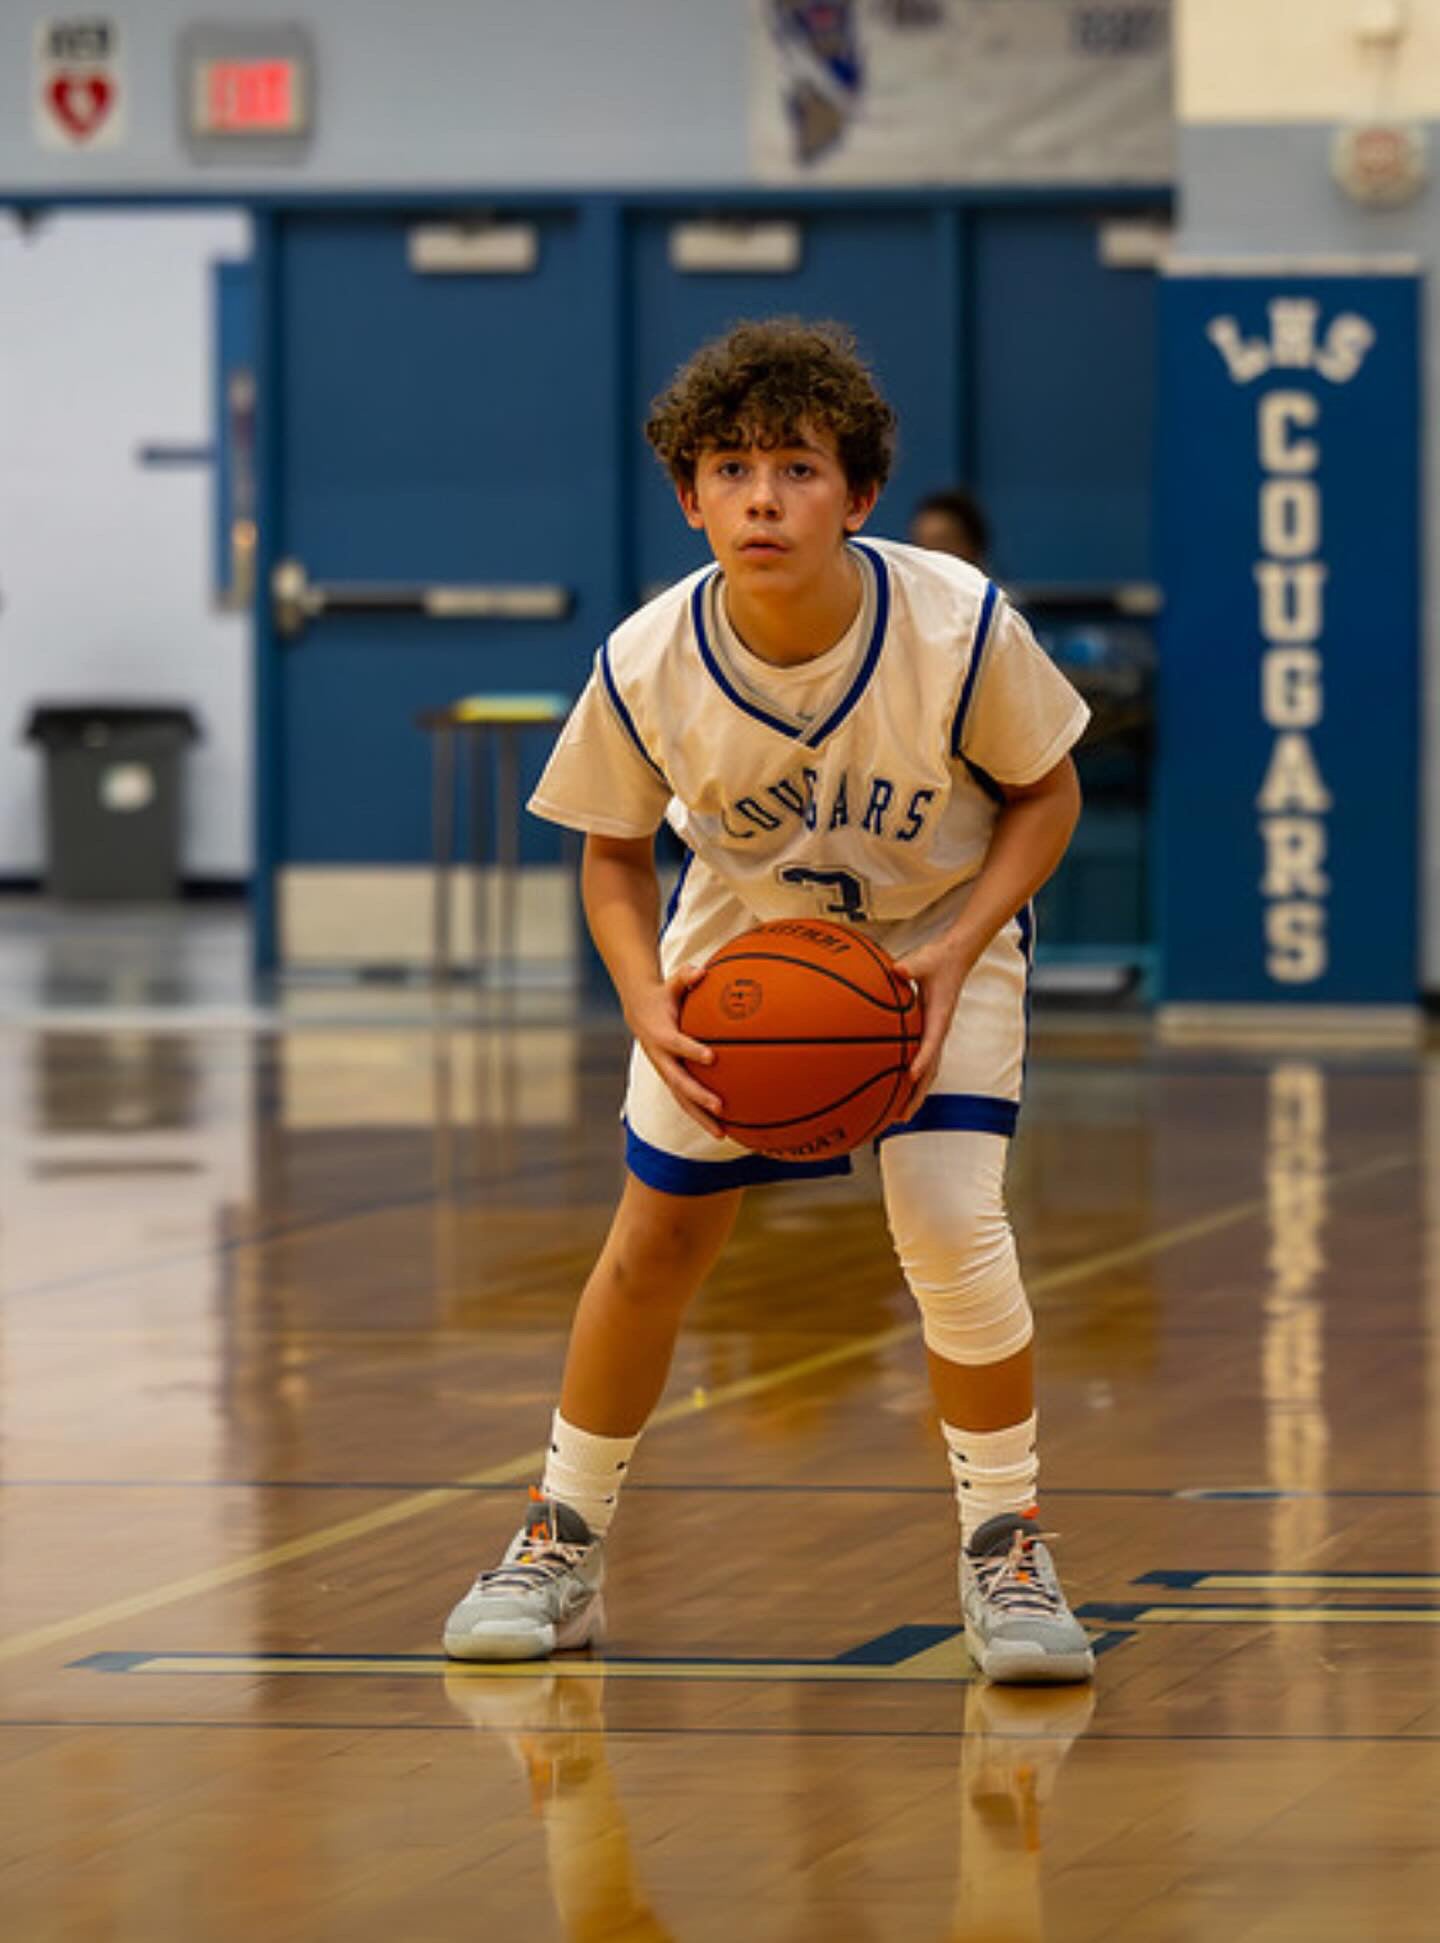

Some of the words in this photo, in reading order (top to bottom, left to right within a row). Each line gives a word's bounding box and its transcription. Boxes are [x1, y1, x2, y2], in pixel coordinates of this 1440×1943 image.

[206, 58, 293, 131] EXIT
[1207, 297, 1375, 383] LHS
[1255, 390, 1331, 983] COUGARS
